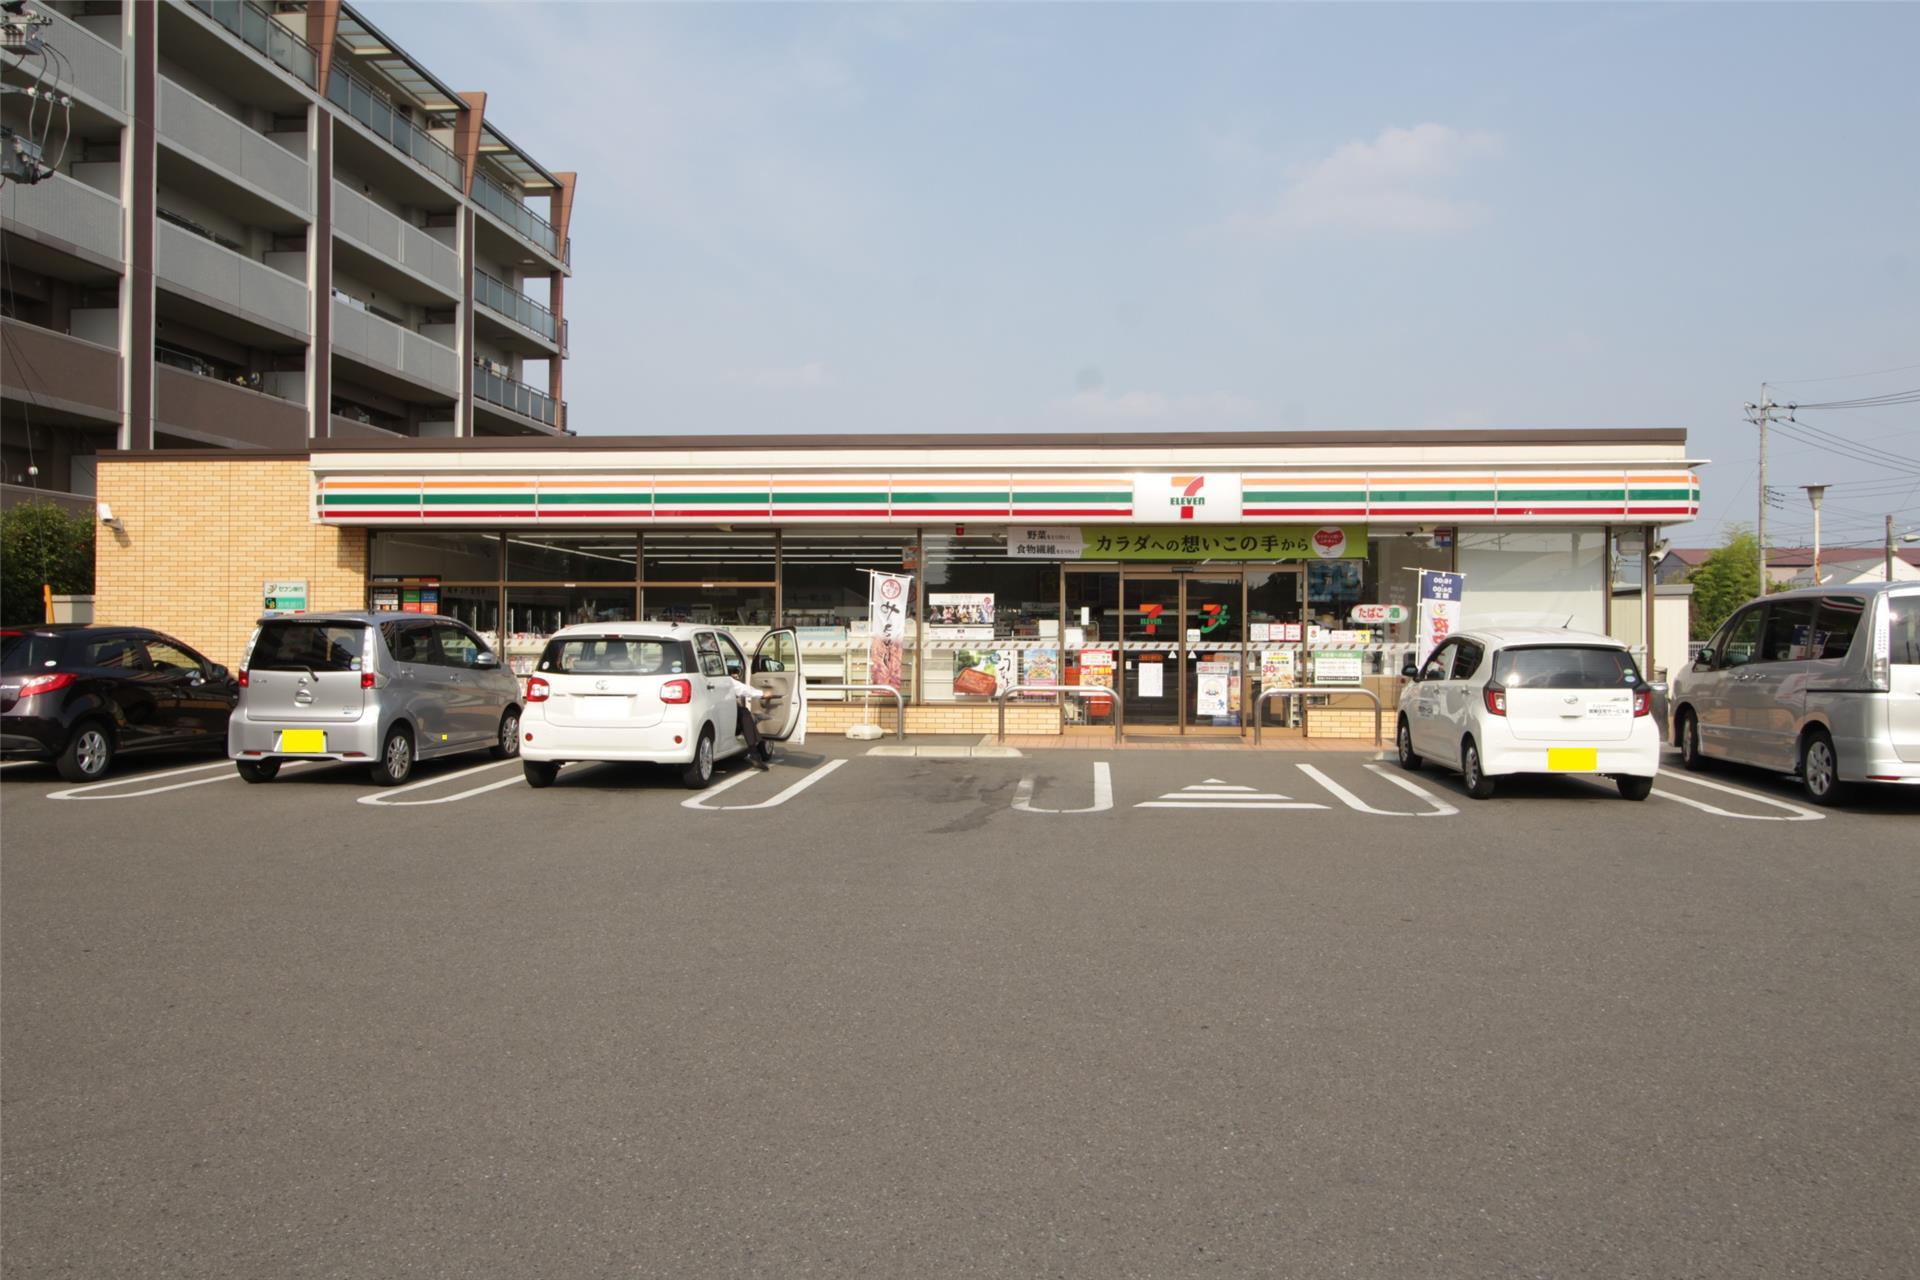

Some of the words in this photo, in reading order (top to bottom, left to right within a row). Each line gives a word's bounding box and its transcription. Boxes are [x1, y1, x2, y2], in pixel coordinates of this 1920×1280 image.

[1095, 535, 1309, 553] カラダへの想いこの手から
[1358, 606, 1384, 619] たばこ
